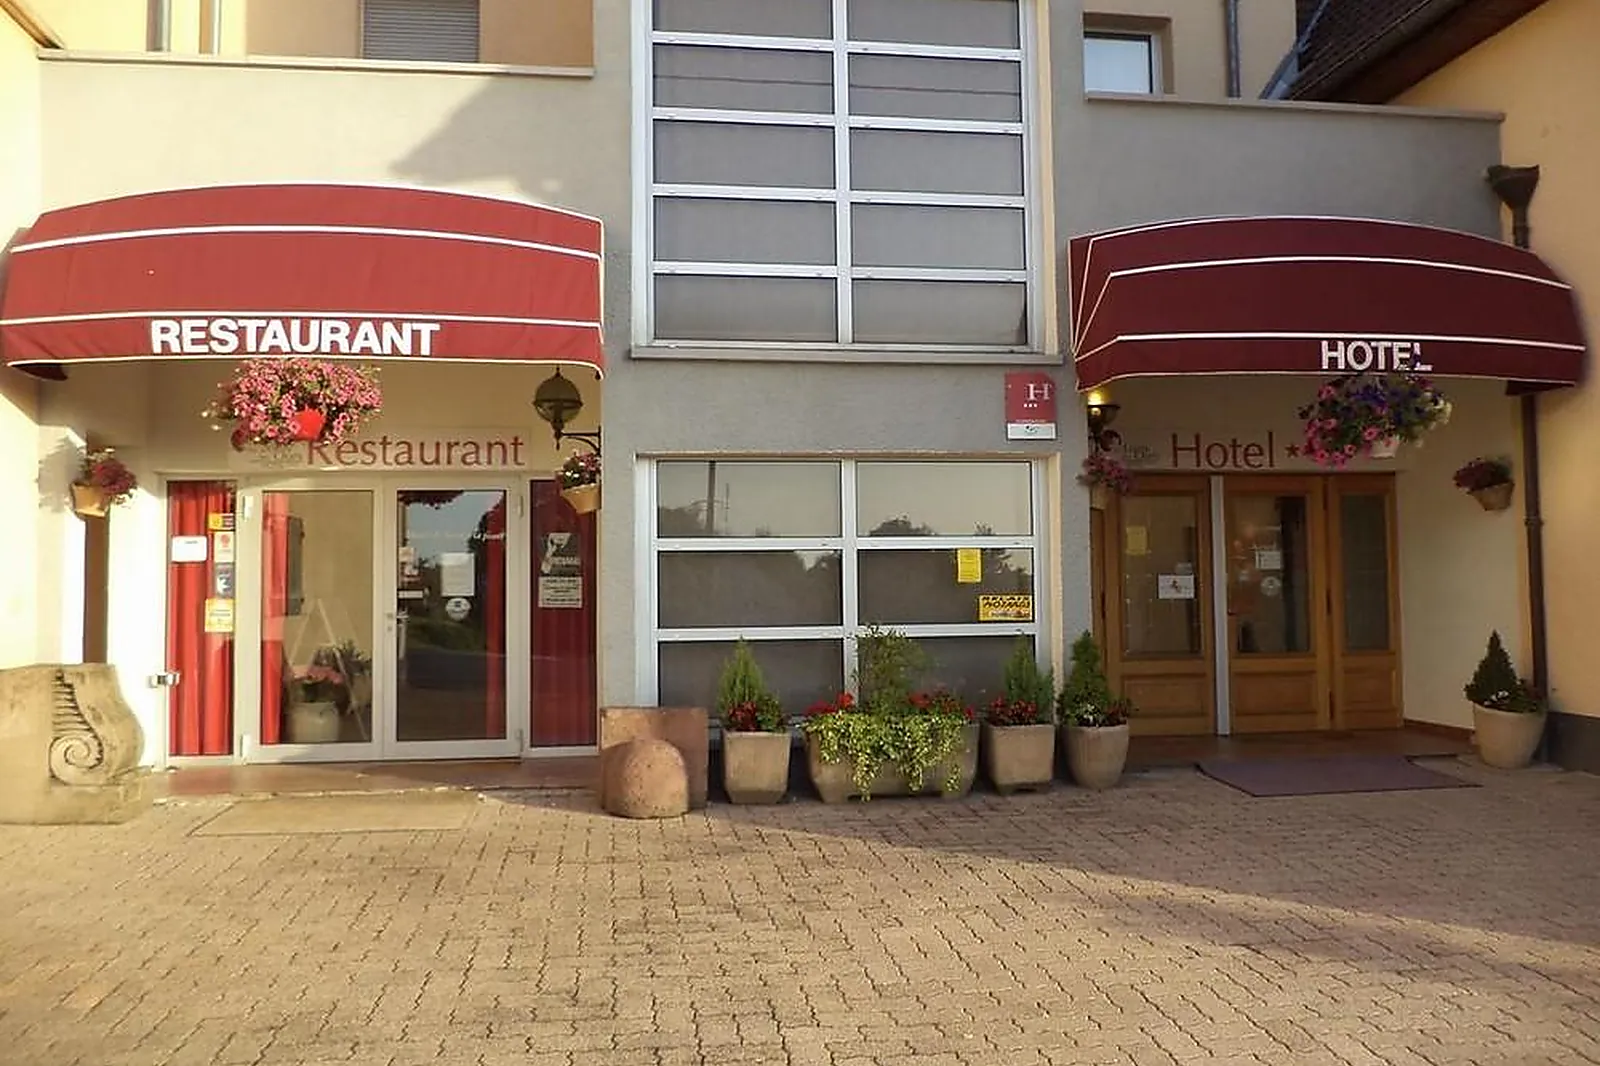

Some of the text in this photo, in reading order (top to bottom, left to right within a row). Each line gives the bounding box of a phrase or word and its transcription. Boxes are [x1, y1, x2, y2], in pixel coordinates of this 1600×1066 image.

[151, 320, 440, 355] RESTAURANT
[1321, 340, 1433, 371] HOTEL
[307, 435, 524, 466] Restaurant
[1172, 432, 1273, 469] Hotel
